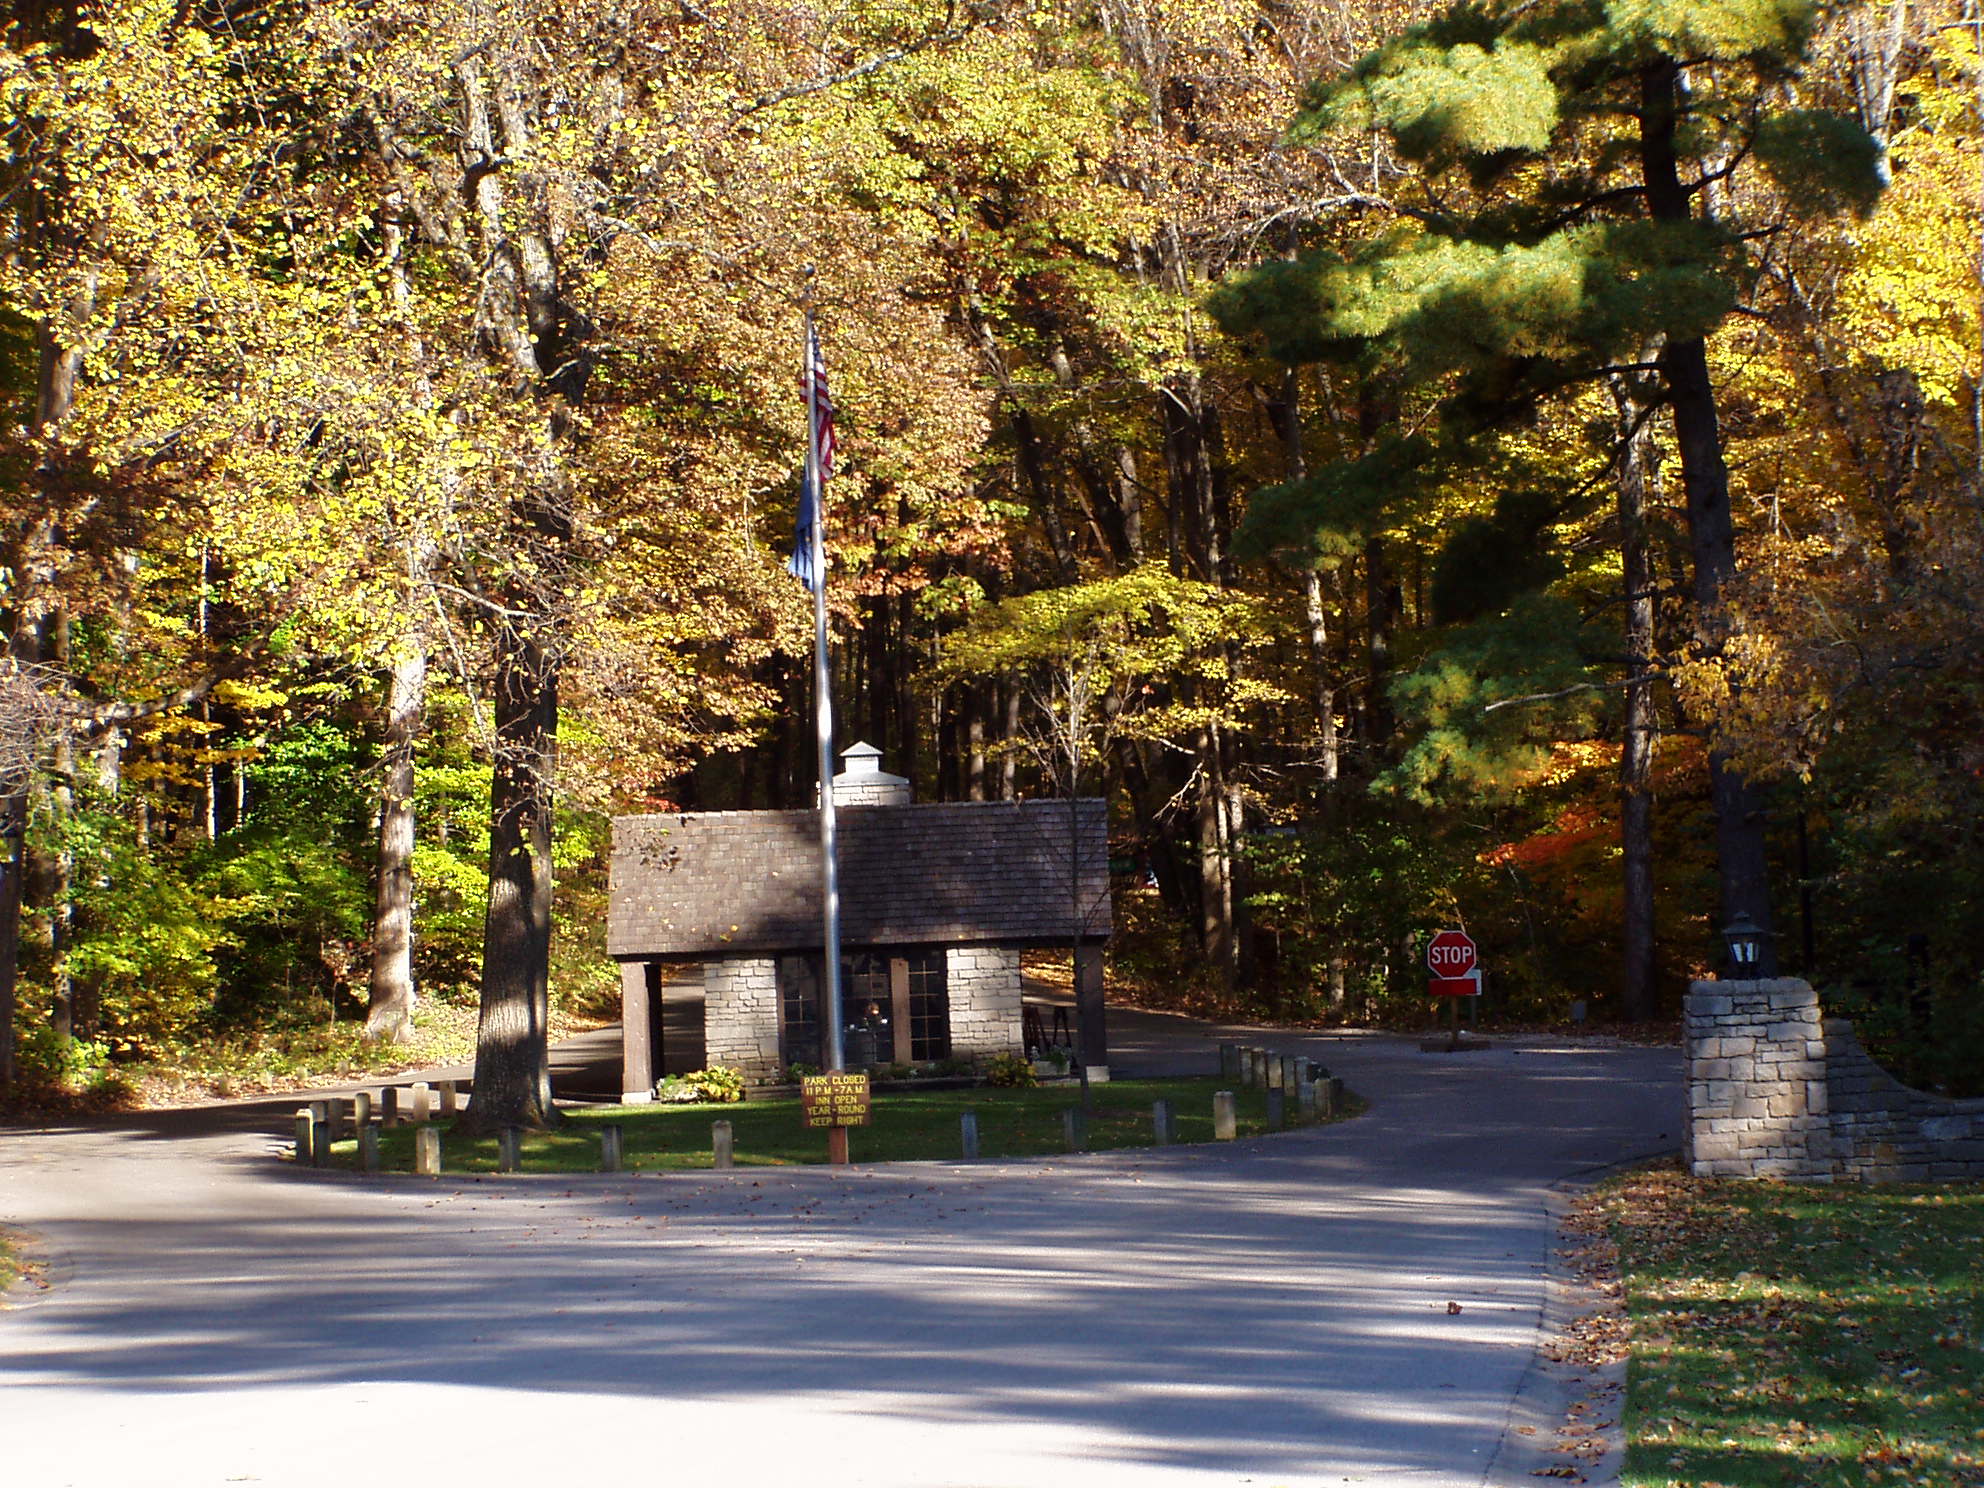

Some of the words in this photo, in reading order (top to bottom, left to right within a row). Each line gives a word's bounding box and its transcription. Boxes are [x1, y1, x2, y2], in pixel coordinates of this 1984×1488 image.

[1431, 946, 1473, 964] STOP
[803, 1076, 828, 1086] PARK
[832, 1075, 866, 1085] CLOSED
[834, 1095, 857, 1104] OPEN
[810, 1117, 832, 1126] KEEP
[836, 1115, 864, 1125] RIGHT
